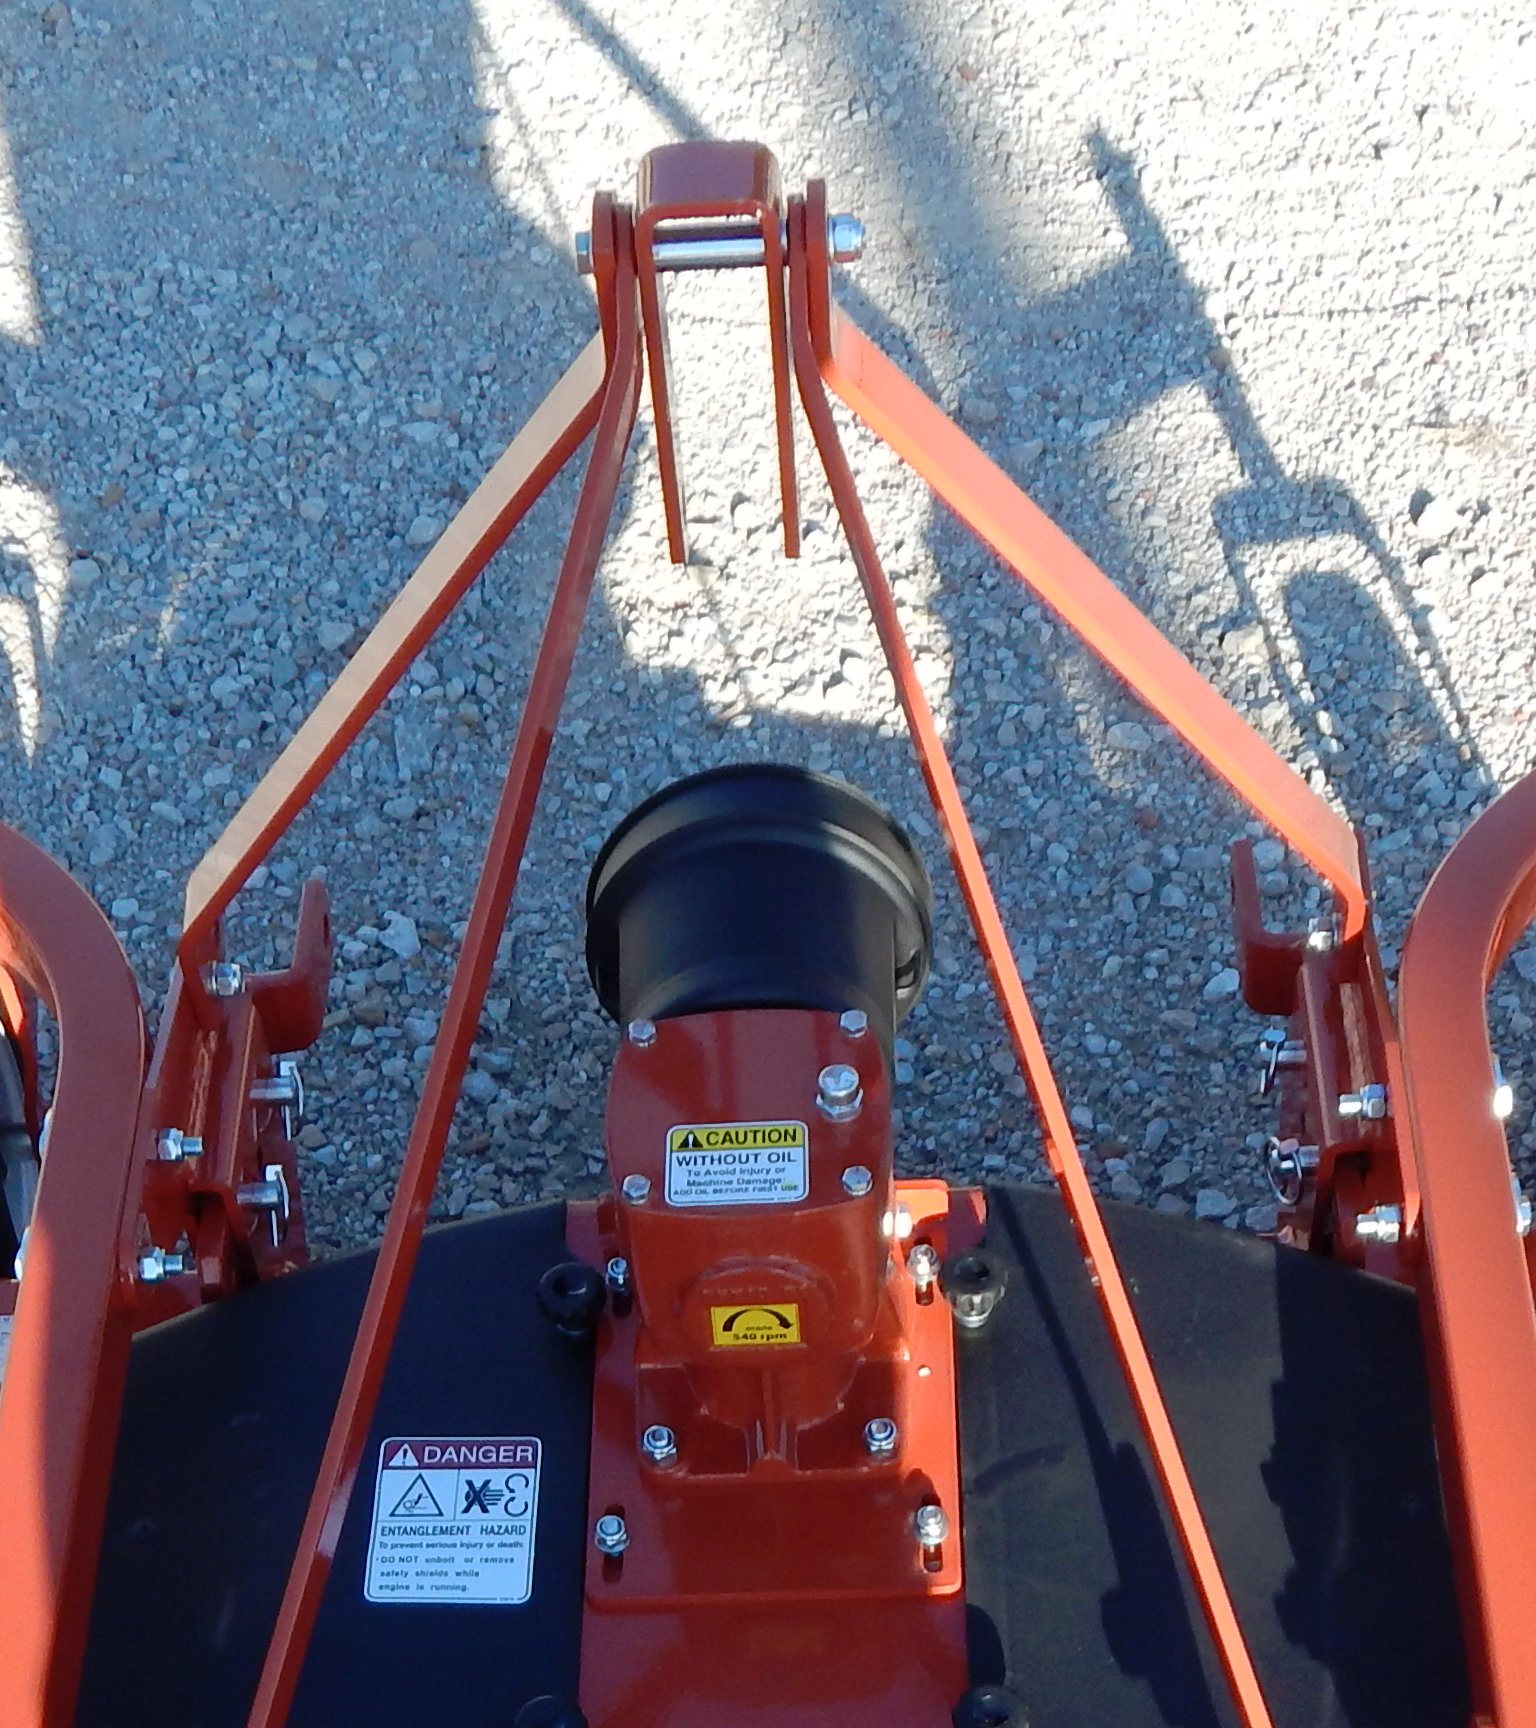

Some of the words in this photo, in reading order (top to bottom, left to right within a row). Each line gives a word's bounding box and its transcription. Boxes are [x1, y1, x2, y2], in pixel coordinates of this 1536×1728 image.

[706, 1128, 797, 1146] CAUTION
[676, 1152, 761, 1167] WITHOUT
[767, 1151, 797, 1164] OIL
[687, 1169, 700, 1177] To
[704, 1167, 736, 1177] Avoid
[739, 1166, 771, 1177] Injury
[686, 1178, 734, 1188] Machine
[673, 1187, 692, 1196] ADD
[732, 1333, 757, 1341] 540
[760, 1332, 787, 1341] rpm
[423, 1445, 533, 1463] DANGER
[380, 1525, 472, 1537] ENTANGLEMENT
[480, 1524, 527, 1536] HAZARD
[390, 1541, 424, 1550] prevent
[425, 1541, 458, 1549] serious
[381, 1556, 395, 1564] DO
[398, 1555, 419, 1563] NOT
[425, 1555, 455, 1563] unbolt
[480, 1556, 515, 1564] remove
[380, 1569, 409, 1578] safety
[415, 1569, 449, 1577] shields
[455, 1569, 480, 1577] while
[378, 1583, 410, 1592] engine
[430, 1583, 470, 1592] running.
